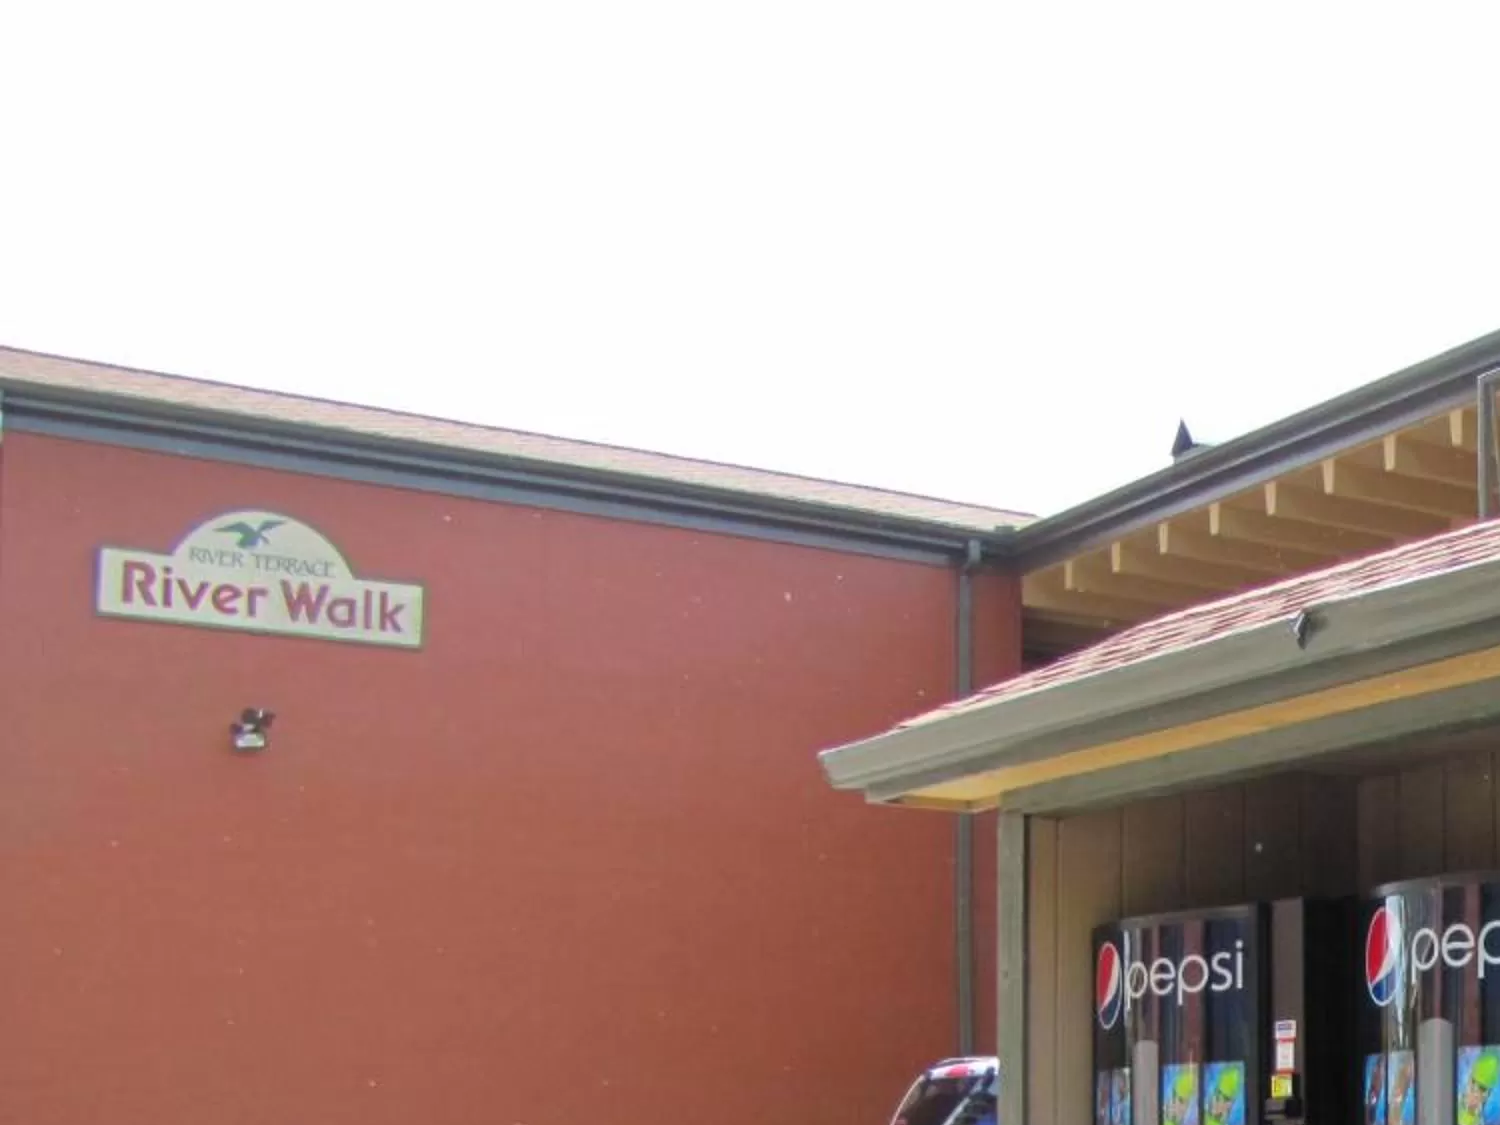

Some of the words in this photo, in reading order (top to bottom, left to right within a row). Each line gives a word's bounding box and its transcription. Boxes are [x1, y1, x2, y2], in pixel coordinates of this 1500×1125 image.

[121, 559, 269, 619] River
[279, 578, 406, 633] Walk
[188, 549, 243, 569] RIVER
[250, 553, 337, 578] TERRACE
[1125, 939, 1244, 1011] pepsi
